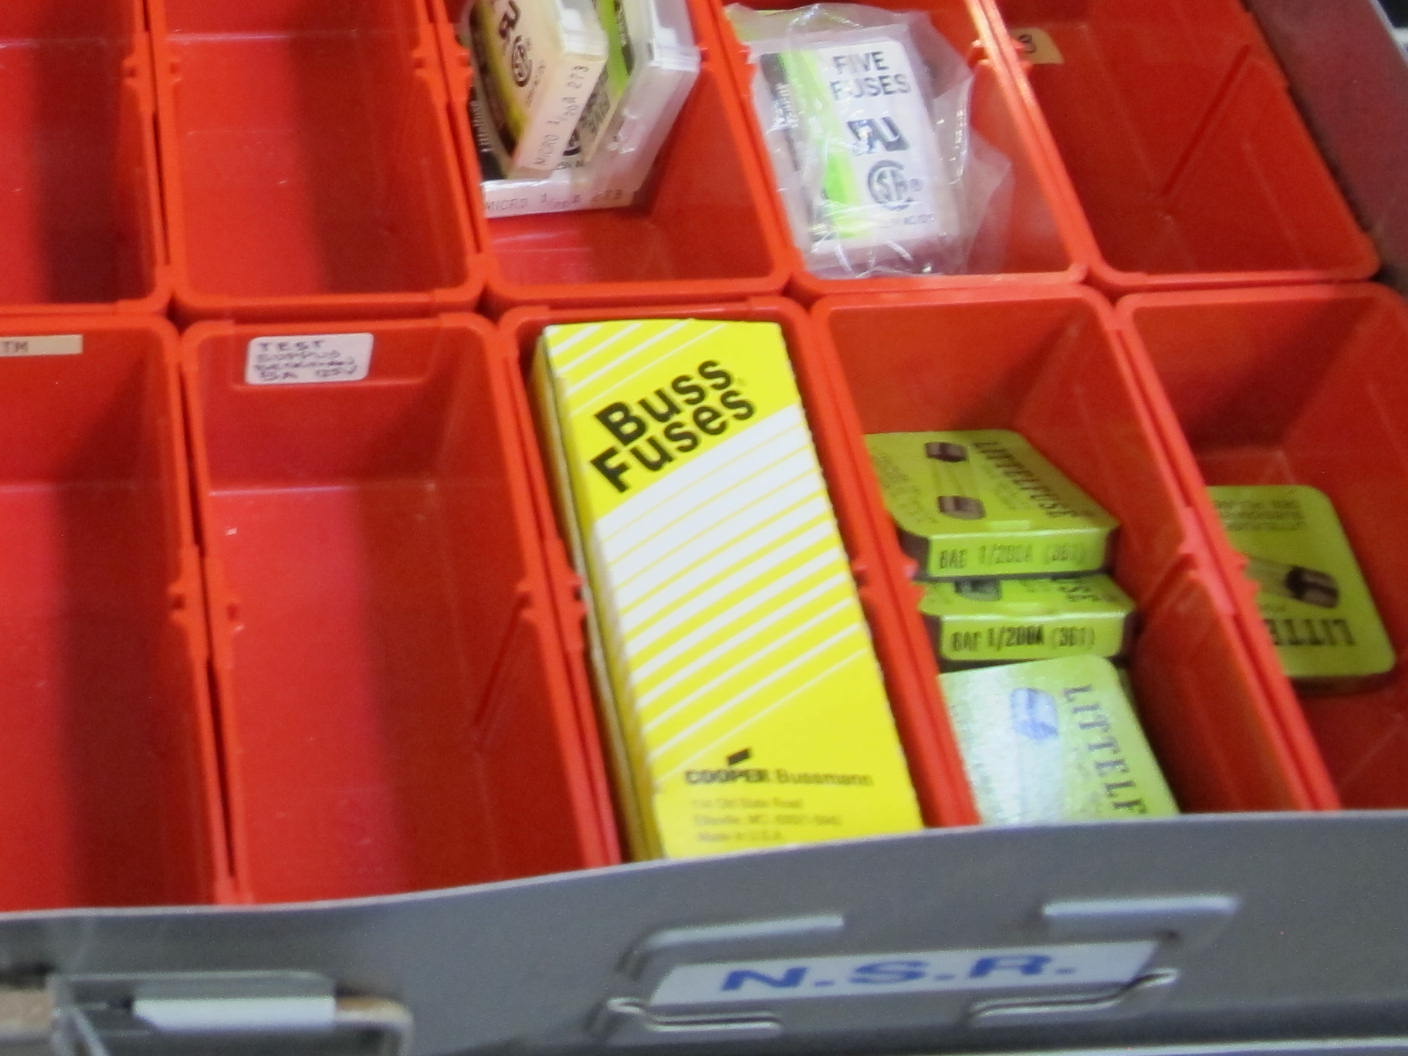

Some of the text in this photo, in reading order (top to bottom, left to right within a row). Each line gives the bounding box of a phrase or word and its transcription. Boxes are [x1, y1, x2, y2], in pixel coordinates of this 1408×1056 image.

[594, 359, 732, 446] Buss
[590, 390, 756, 493] Fuses
[685, 769, 770, 784] COOPER
[721, 954, 1076, 991] N.S.R.
